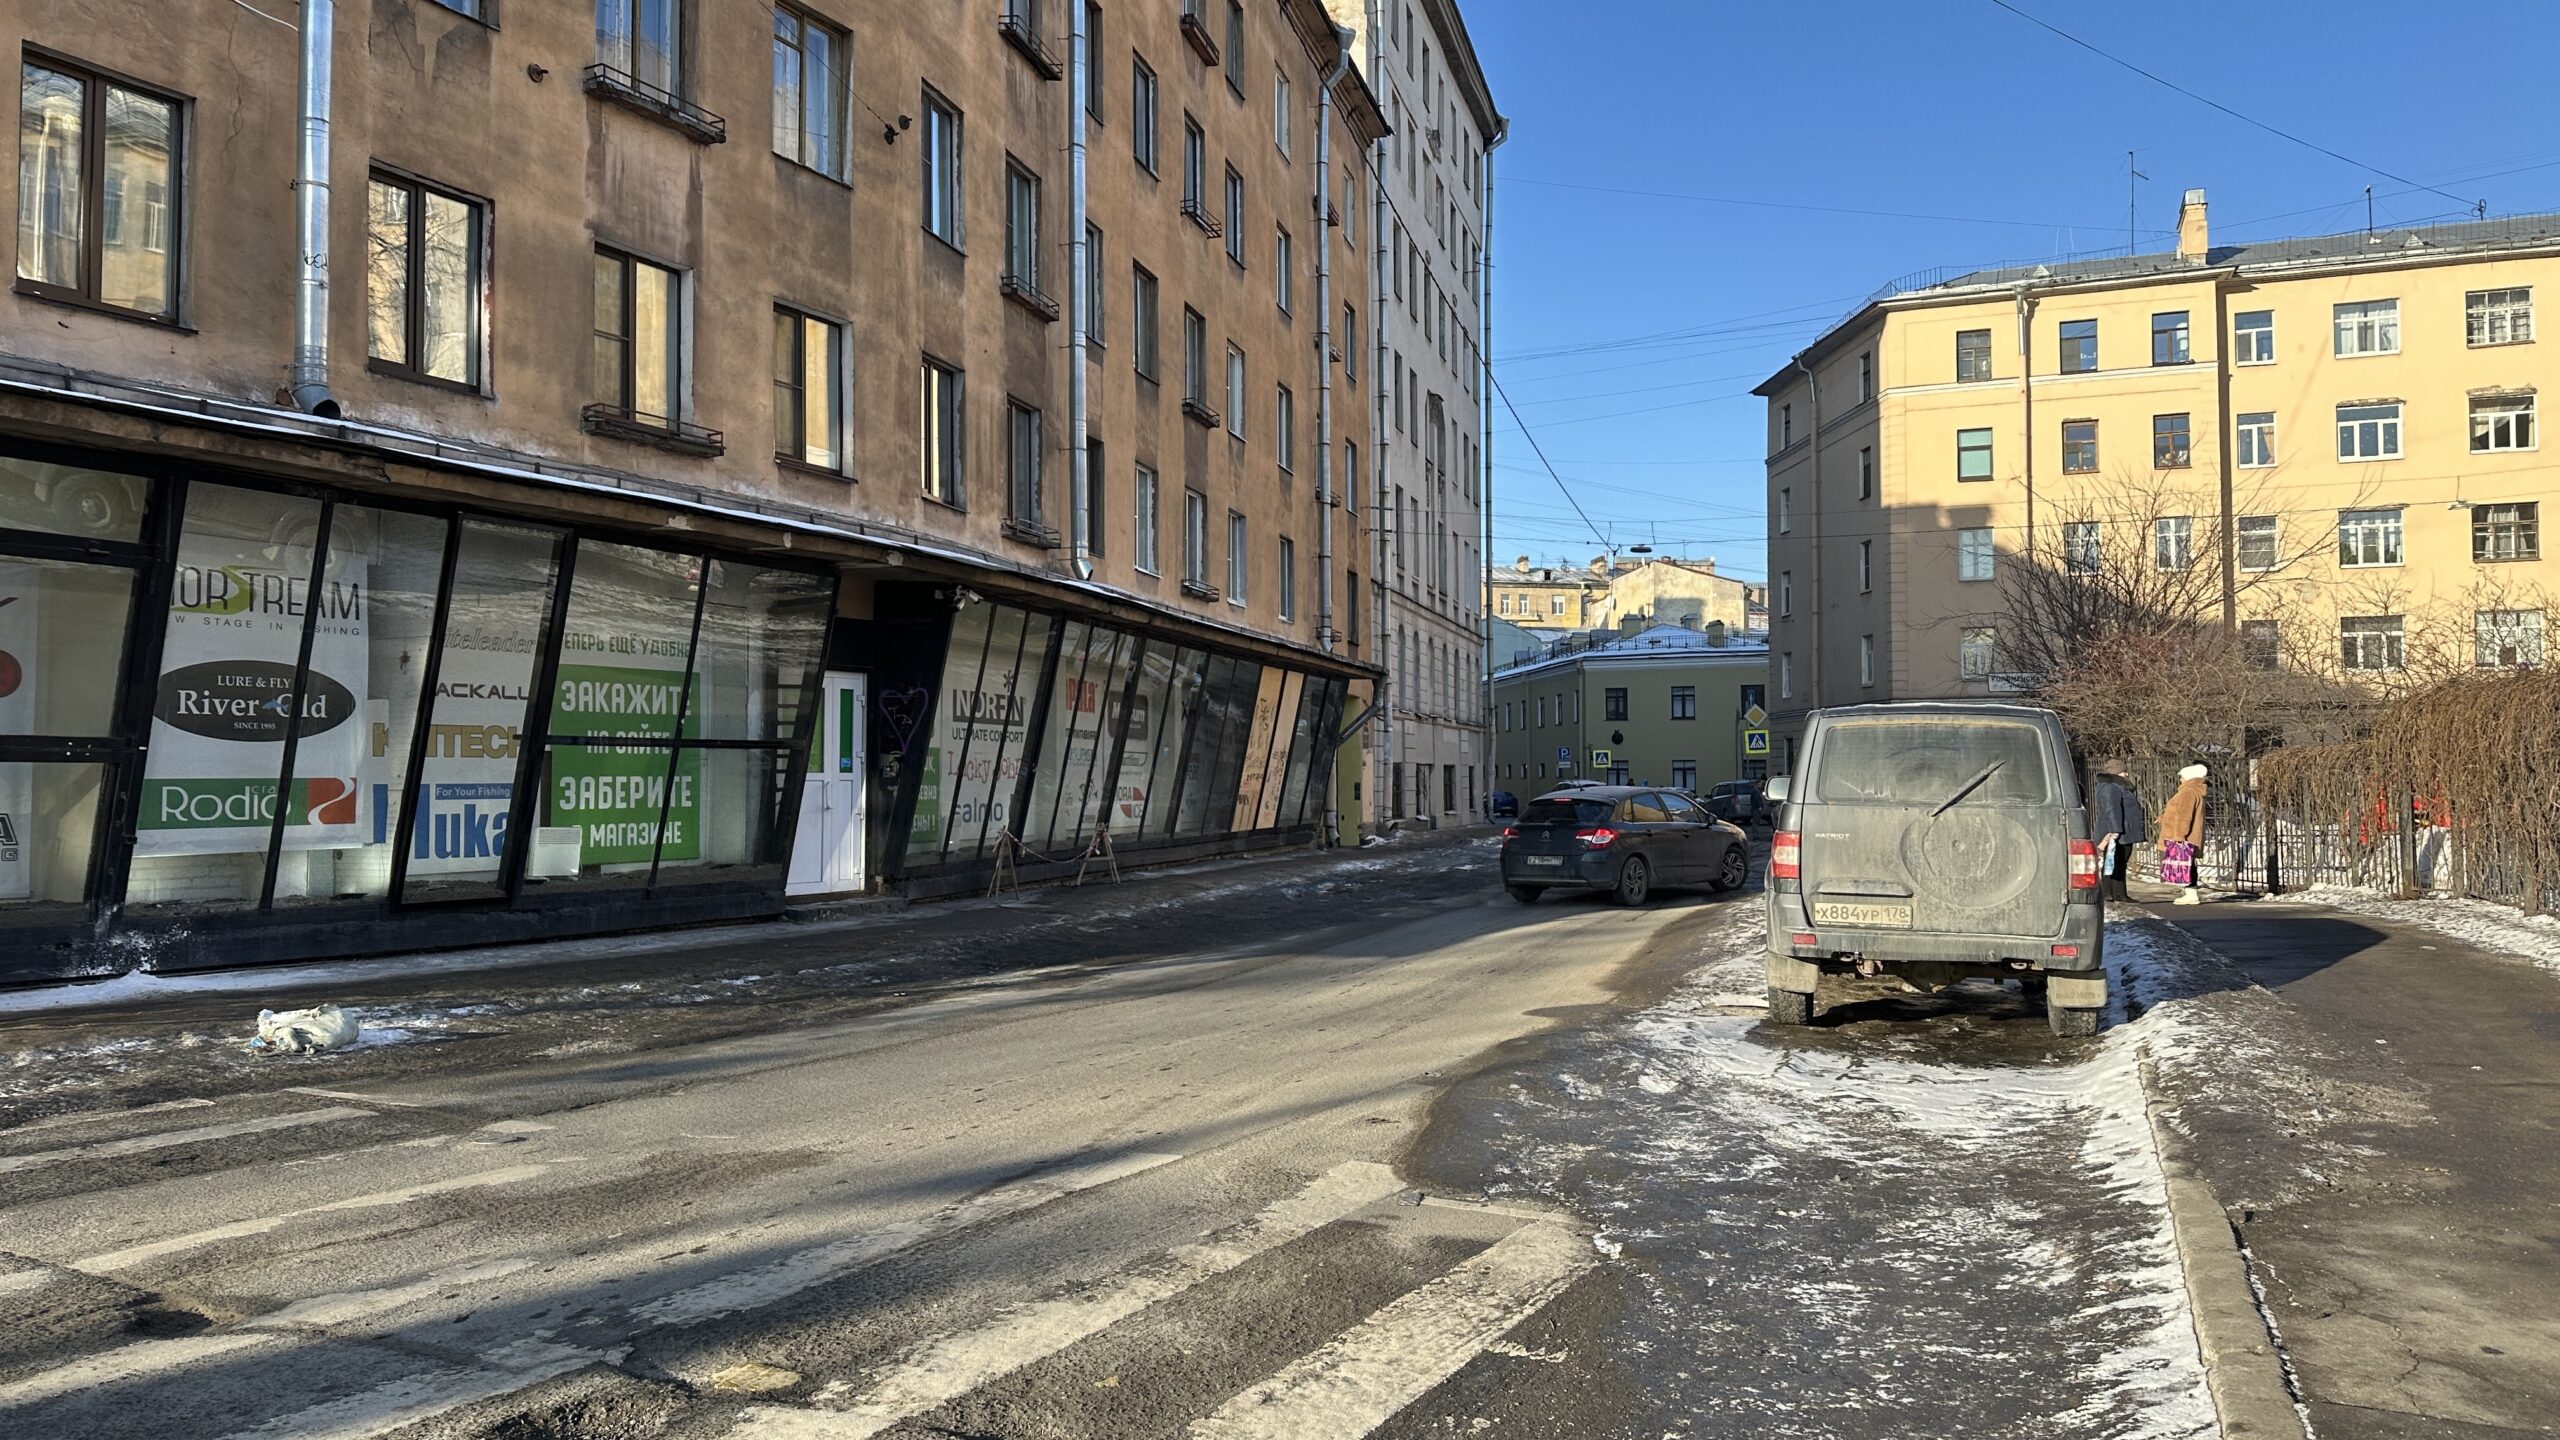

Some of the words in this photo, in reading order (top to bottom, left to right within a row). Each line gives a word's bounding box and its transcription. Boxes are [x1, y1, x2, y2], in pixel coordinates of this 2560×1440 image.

[203, 616, 253, 629] STAGE
[269, 621, 284, 631] IN
[444, 627, 537, 654] iteleader
[565, 632, 605, 651] ЕПЕРЬ
[217, 675, 252, 688] LURE
[255, 676, 266, 688] &
[270, 677, 292, 689] FLY
[435, 682, 530, 700] ACKALL
[177, 689, 260, 718] River
[234, 721, 259, 730] SINCE
[436, 787, 452, 797] For
[455, 786, 475, 797] Your
[478, 785, 511, 798] Fishing
[559, 776, 692, 810] ЗАБЕРИТЕ
